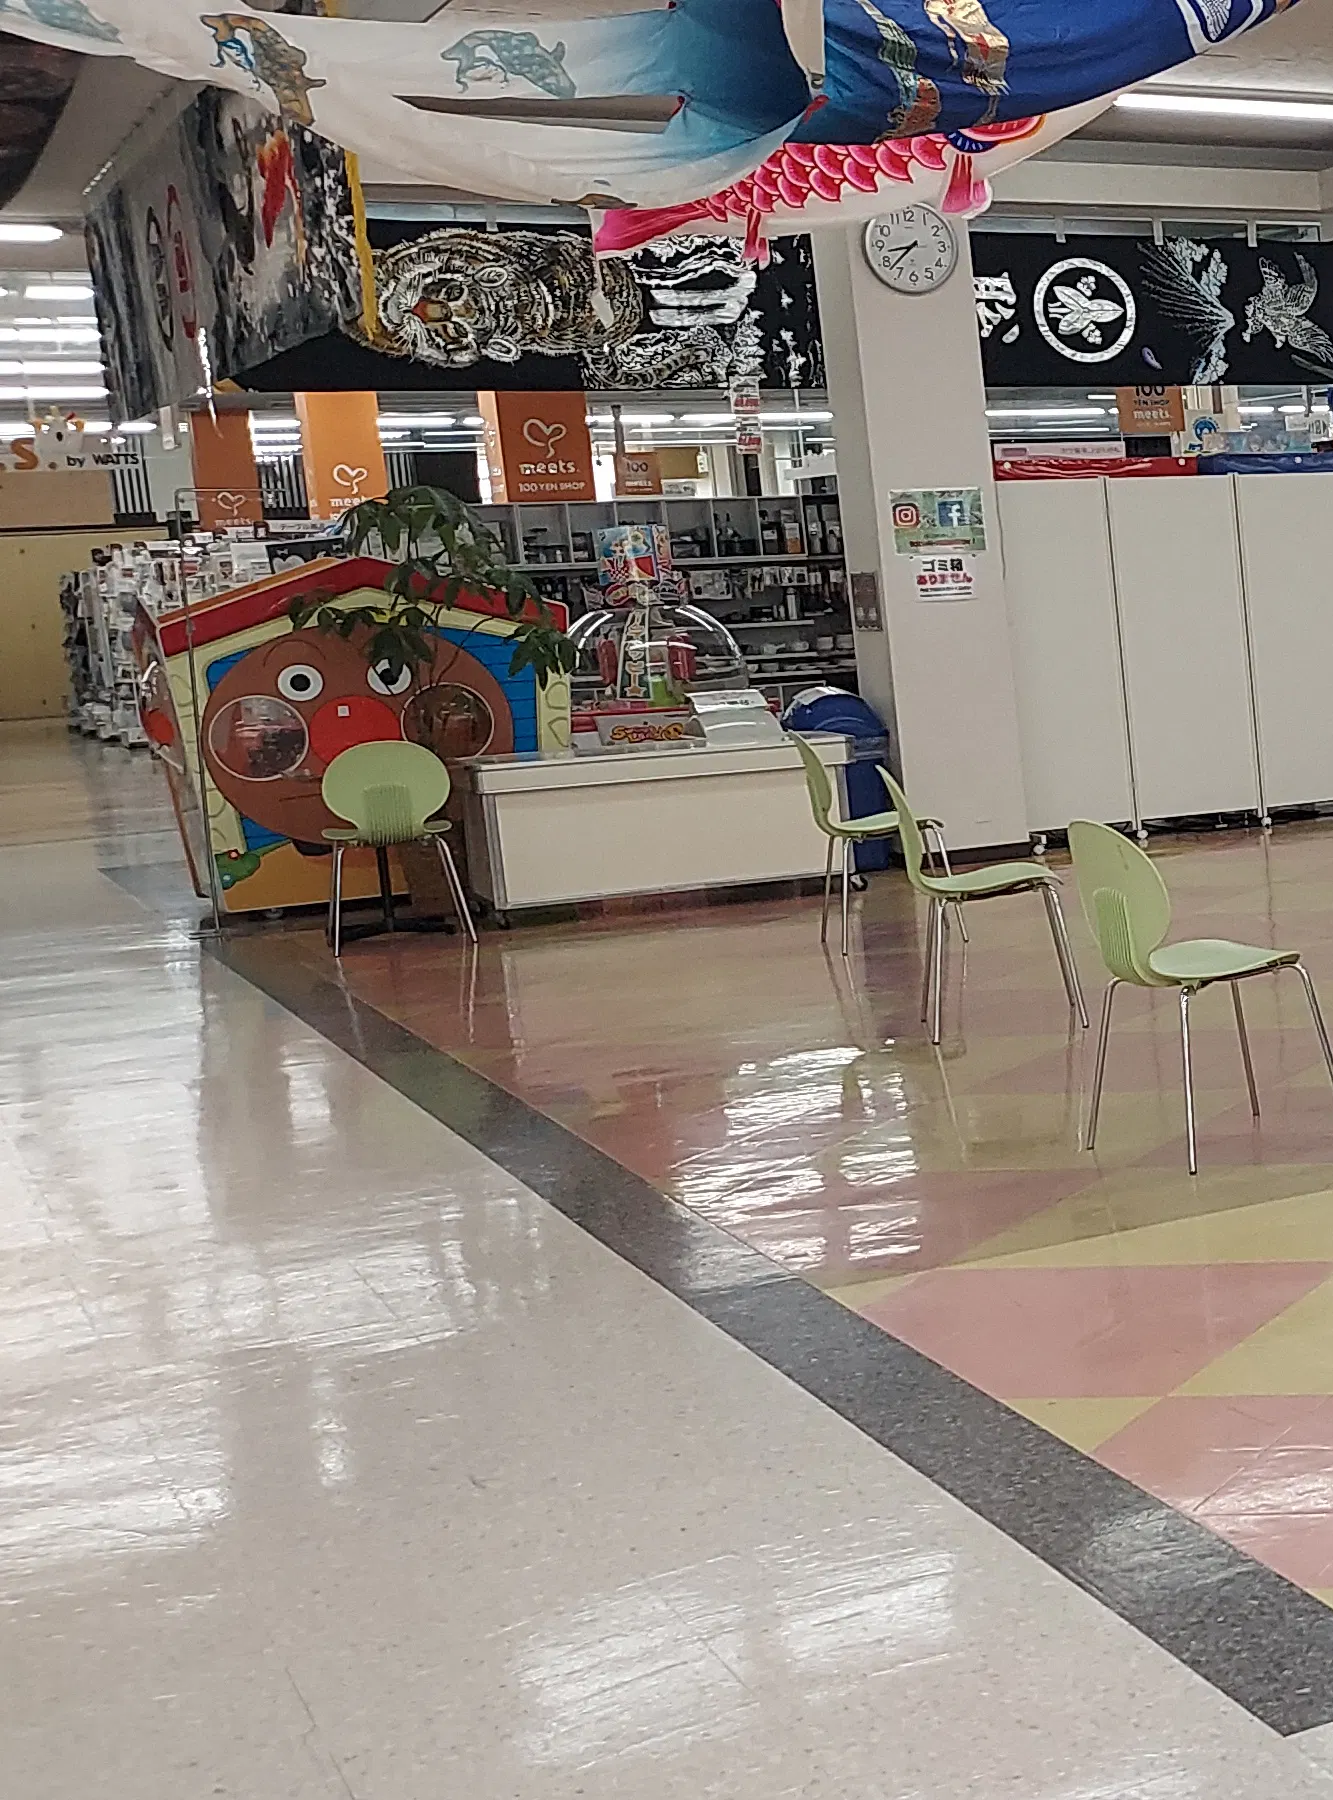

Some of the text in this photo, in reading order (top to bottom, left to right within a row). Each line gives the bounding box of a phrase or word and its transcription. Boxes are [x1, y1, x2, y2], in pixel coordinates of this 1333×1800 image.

[890, 213, 900, 225] 11
[903, 209, 915, 222] 12
[923, 213, 927, 226] 1
[931, 225, 940, 237] 2
[875, 240, 885, 251] 9
[937, 241, 946, 253] 3
[882, 256, 891, 268] 8
[934, 257, 943, 268] 4
[896, 267, 904, 278] 7
[908, 271, 919, 283] 6
[924, 267, 934, 281] 5
[66, 455, 85, 468] by
[92, 453, 140, 465] WATTS
[626, 460, 649, 473] 100
[518, 460, 581, 475] meets.
[518, 481, 537, 493] 100
[330, 496, 370, 508] meet
[921, 558, 963, 572] ゴミ箱
[916, 573, 973, 586] ありません
